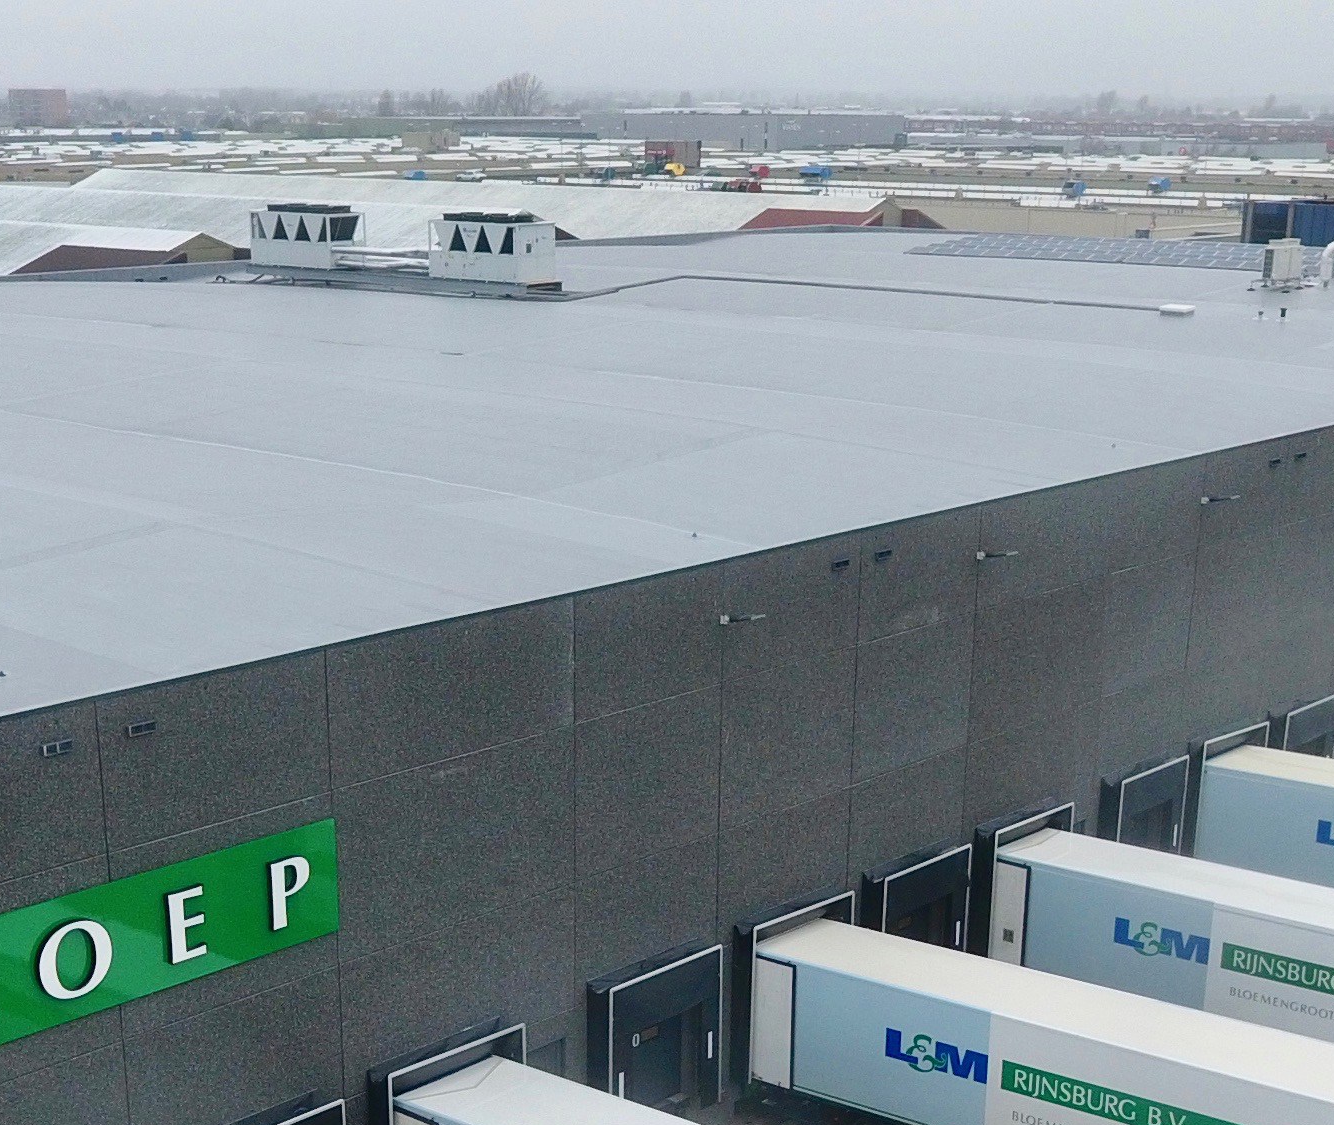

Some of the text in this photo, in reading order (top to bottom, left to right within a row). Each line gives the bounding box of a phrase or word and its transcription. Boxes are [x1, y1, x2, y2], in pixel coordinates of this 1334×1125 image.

[1113, 916, 1211, 966] L&M
[885, 1027, 989, 1085] L&M
[1013, 1068, 1137, 1121] RIJNSBURG
